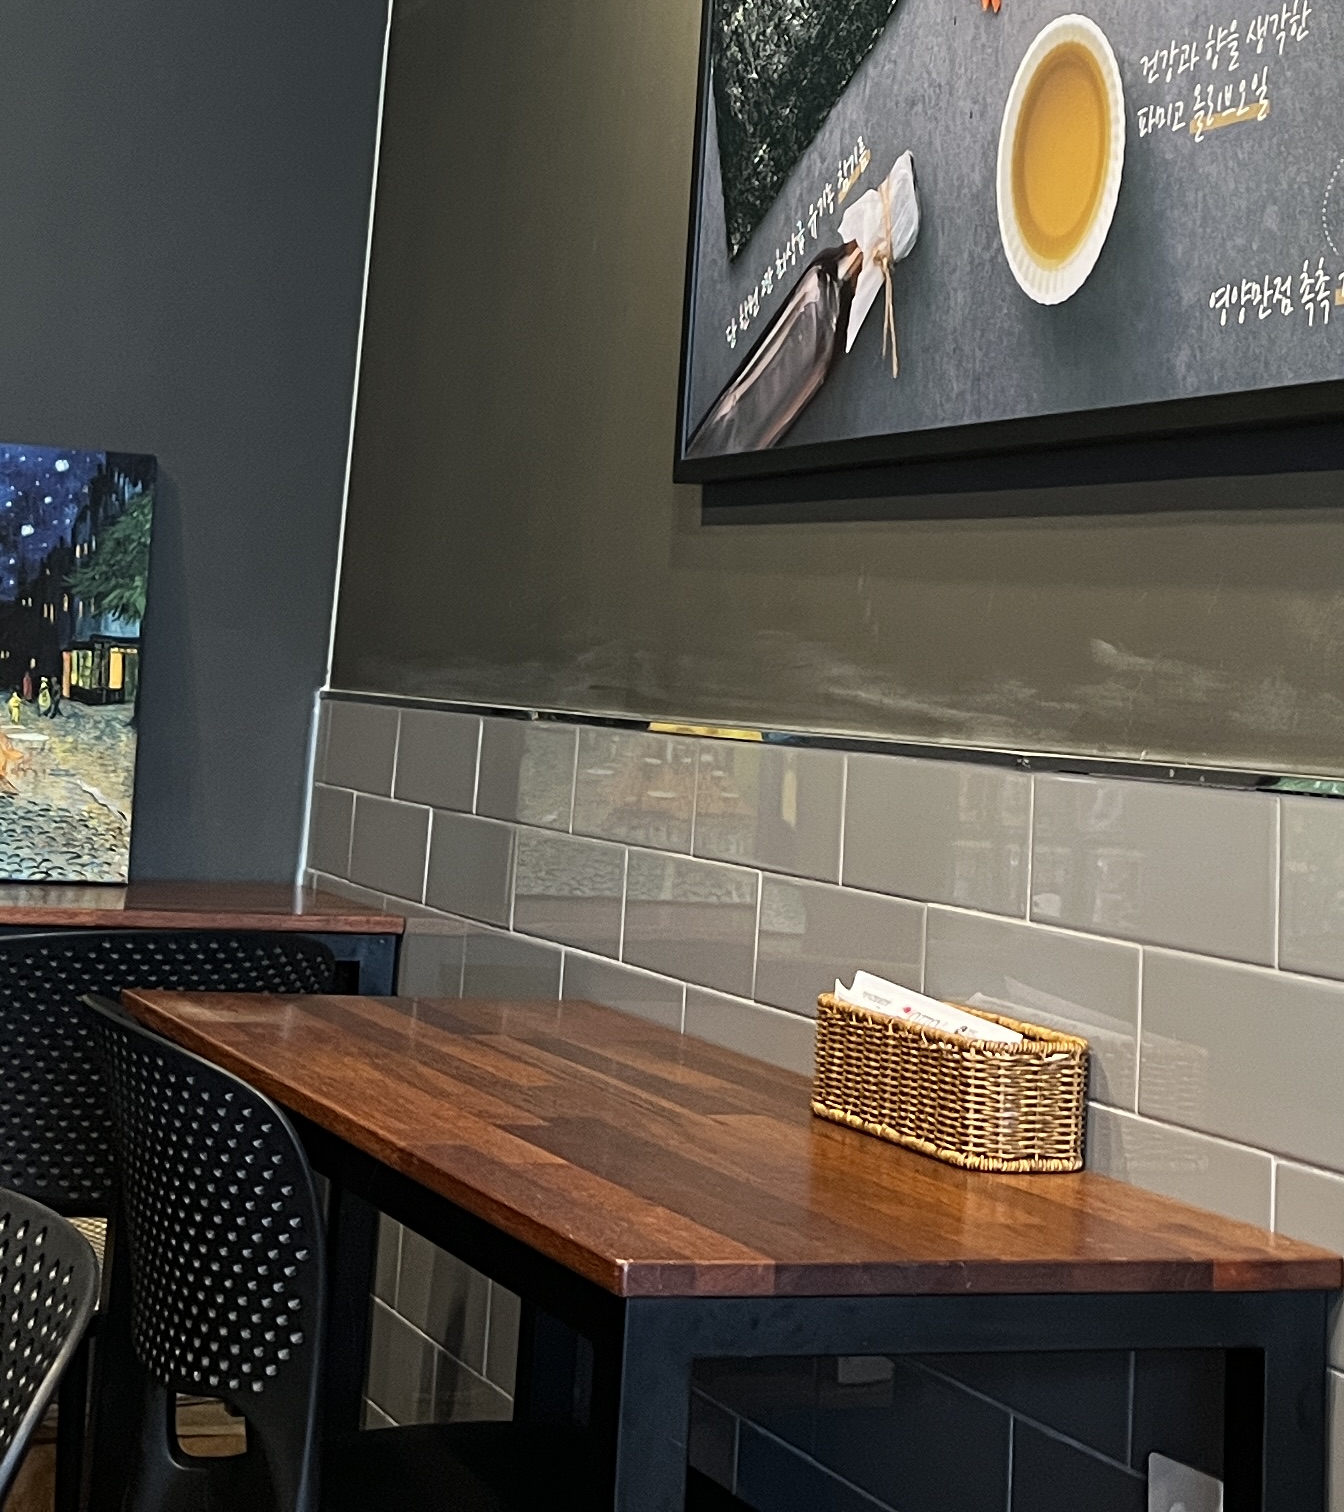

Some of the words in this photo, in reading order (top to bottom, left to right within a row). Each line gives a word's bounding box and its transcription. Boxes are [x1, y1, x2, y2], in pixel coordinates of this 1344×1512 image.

[1140, 40, 1199, 84] 건강과
[1205, 19, 1240, 71] 향을
[1193, 65, 1270, 143] 올리브오일
[1209, 274, 1294, 327] 영양만점
[1299, 256, 1331, 327] 촉촉
